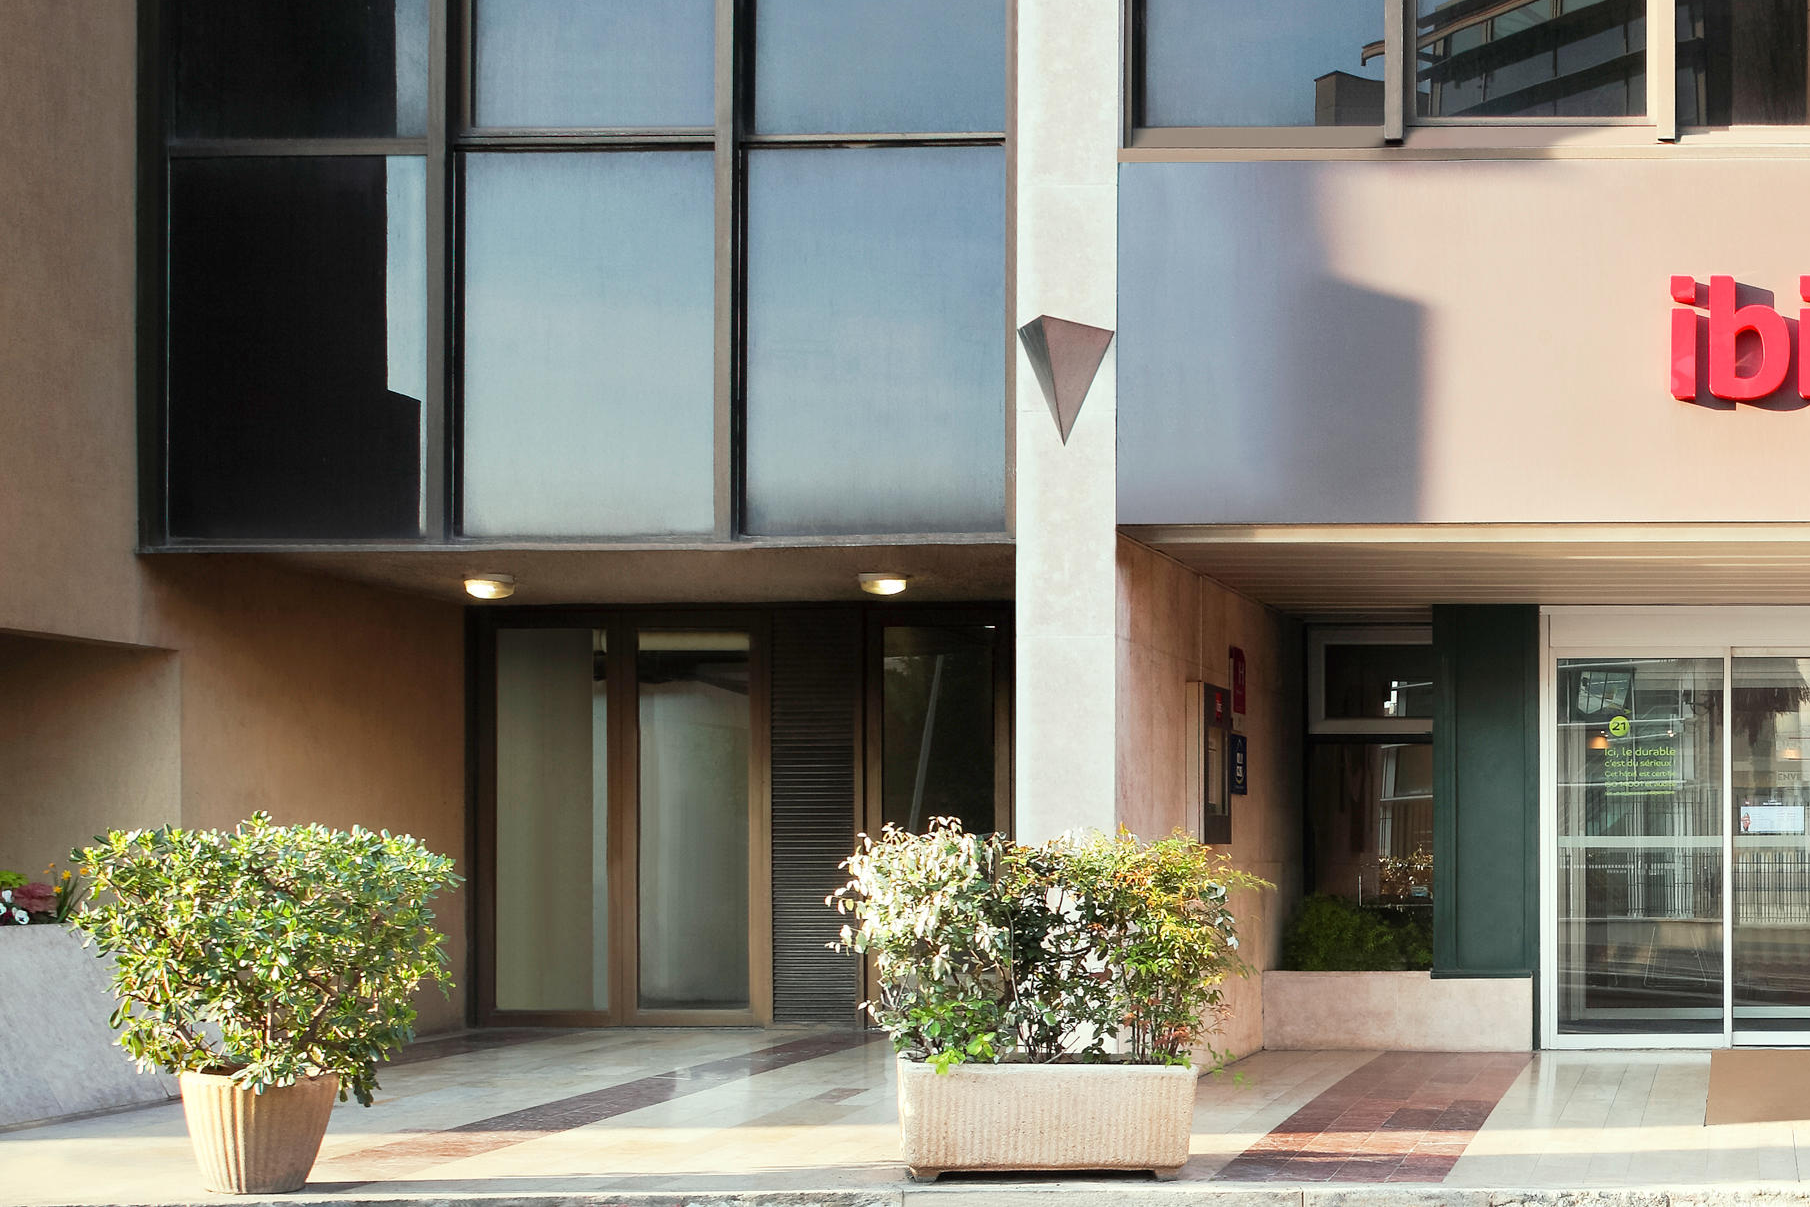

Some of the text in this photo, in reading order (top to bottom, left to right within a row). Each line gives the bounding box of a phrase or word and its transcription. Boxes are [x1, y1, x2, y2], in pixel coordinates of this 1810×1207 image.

[1612, 721, 1626, 731] 21
[1604, 746, 1676, 758] Ici, le durable
[1627, 759, 1639, 767] du
[1640, 759, 1672, 767] sérieux
